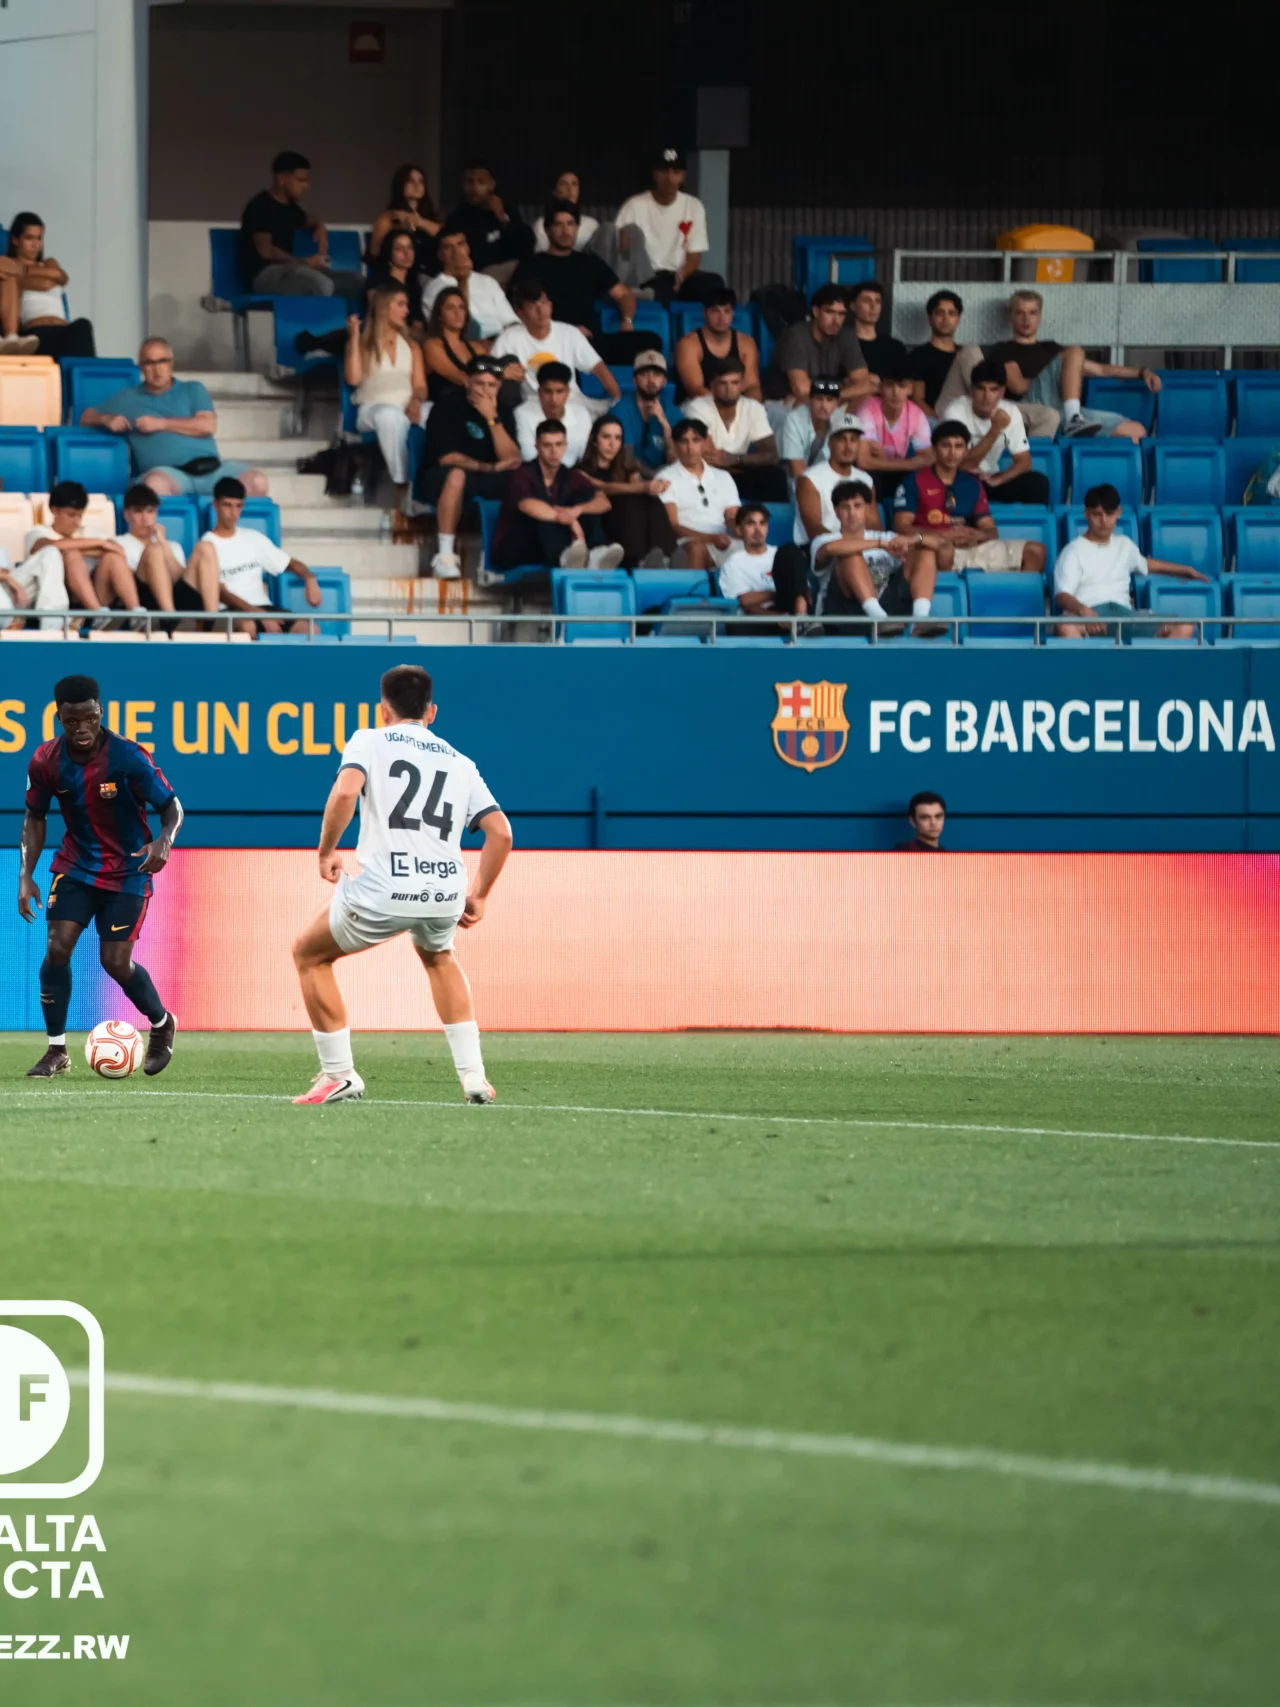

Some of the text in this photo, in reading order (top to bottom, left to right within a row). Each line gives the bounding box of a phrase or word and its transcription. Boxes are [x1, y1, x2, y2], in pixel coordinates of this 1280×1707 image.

[173, 701, 249, 755] UN
[267, 701, 384, 755] CLU
[870, 699, 1276, 753] FC BARCELONA
[388, 759, 454, 842] 24
